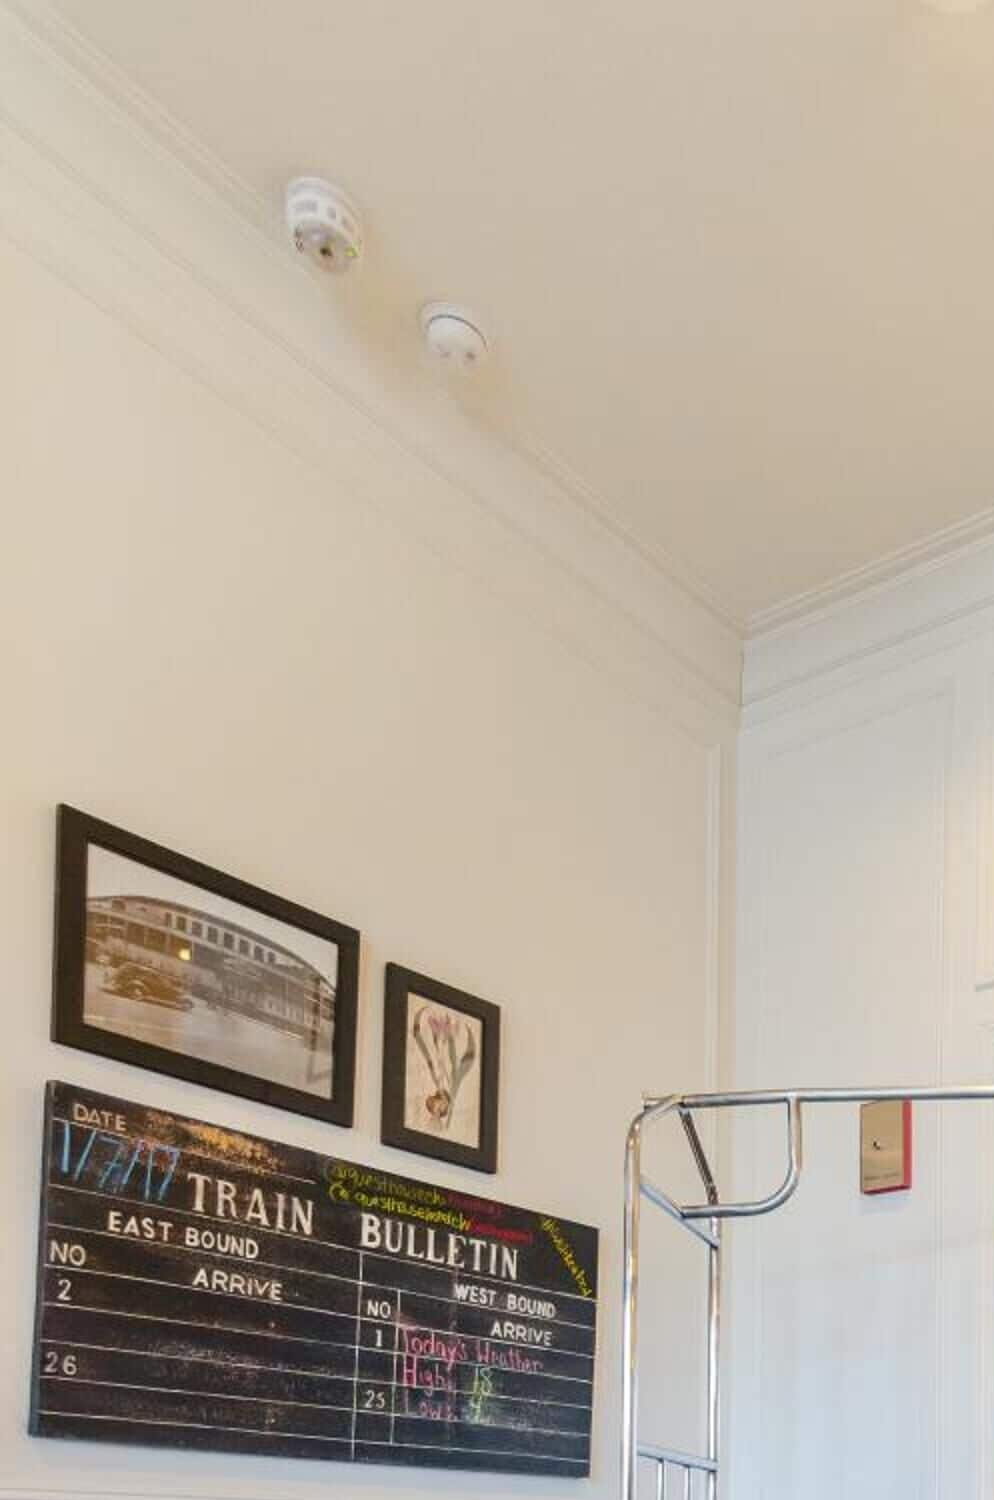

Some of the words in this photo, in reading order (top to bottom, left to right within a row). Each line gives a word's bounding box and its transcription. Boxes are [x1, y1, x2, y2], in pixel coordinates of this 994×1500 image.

[72, 1103, 127, 1131] DATE
[107, 1210, 174, 1242] EAST
[185, 1227, 259, 1259] BOUND
[187, 1172, 316, 1236] TRAIN
[360, 1212, 519, 1281] BULLETIN
[50, 1240, 87, 1267] NO
[57, 1279, 72, 1301] 2
[192, 1267, 284, 1301] ARRIVE
[367, 1300, 391, 1319] NO
[454, 1283, 497, 1307] WEST
[507, 1293, 557, 1319] BOUND
[374, 1330, 384, 1347] 1
[491, 1321, 553, 1346] ARRIVE
[44, 1351, 78, 1376] 26
[364, 1389, 386, 1410] 25
